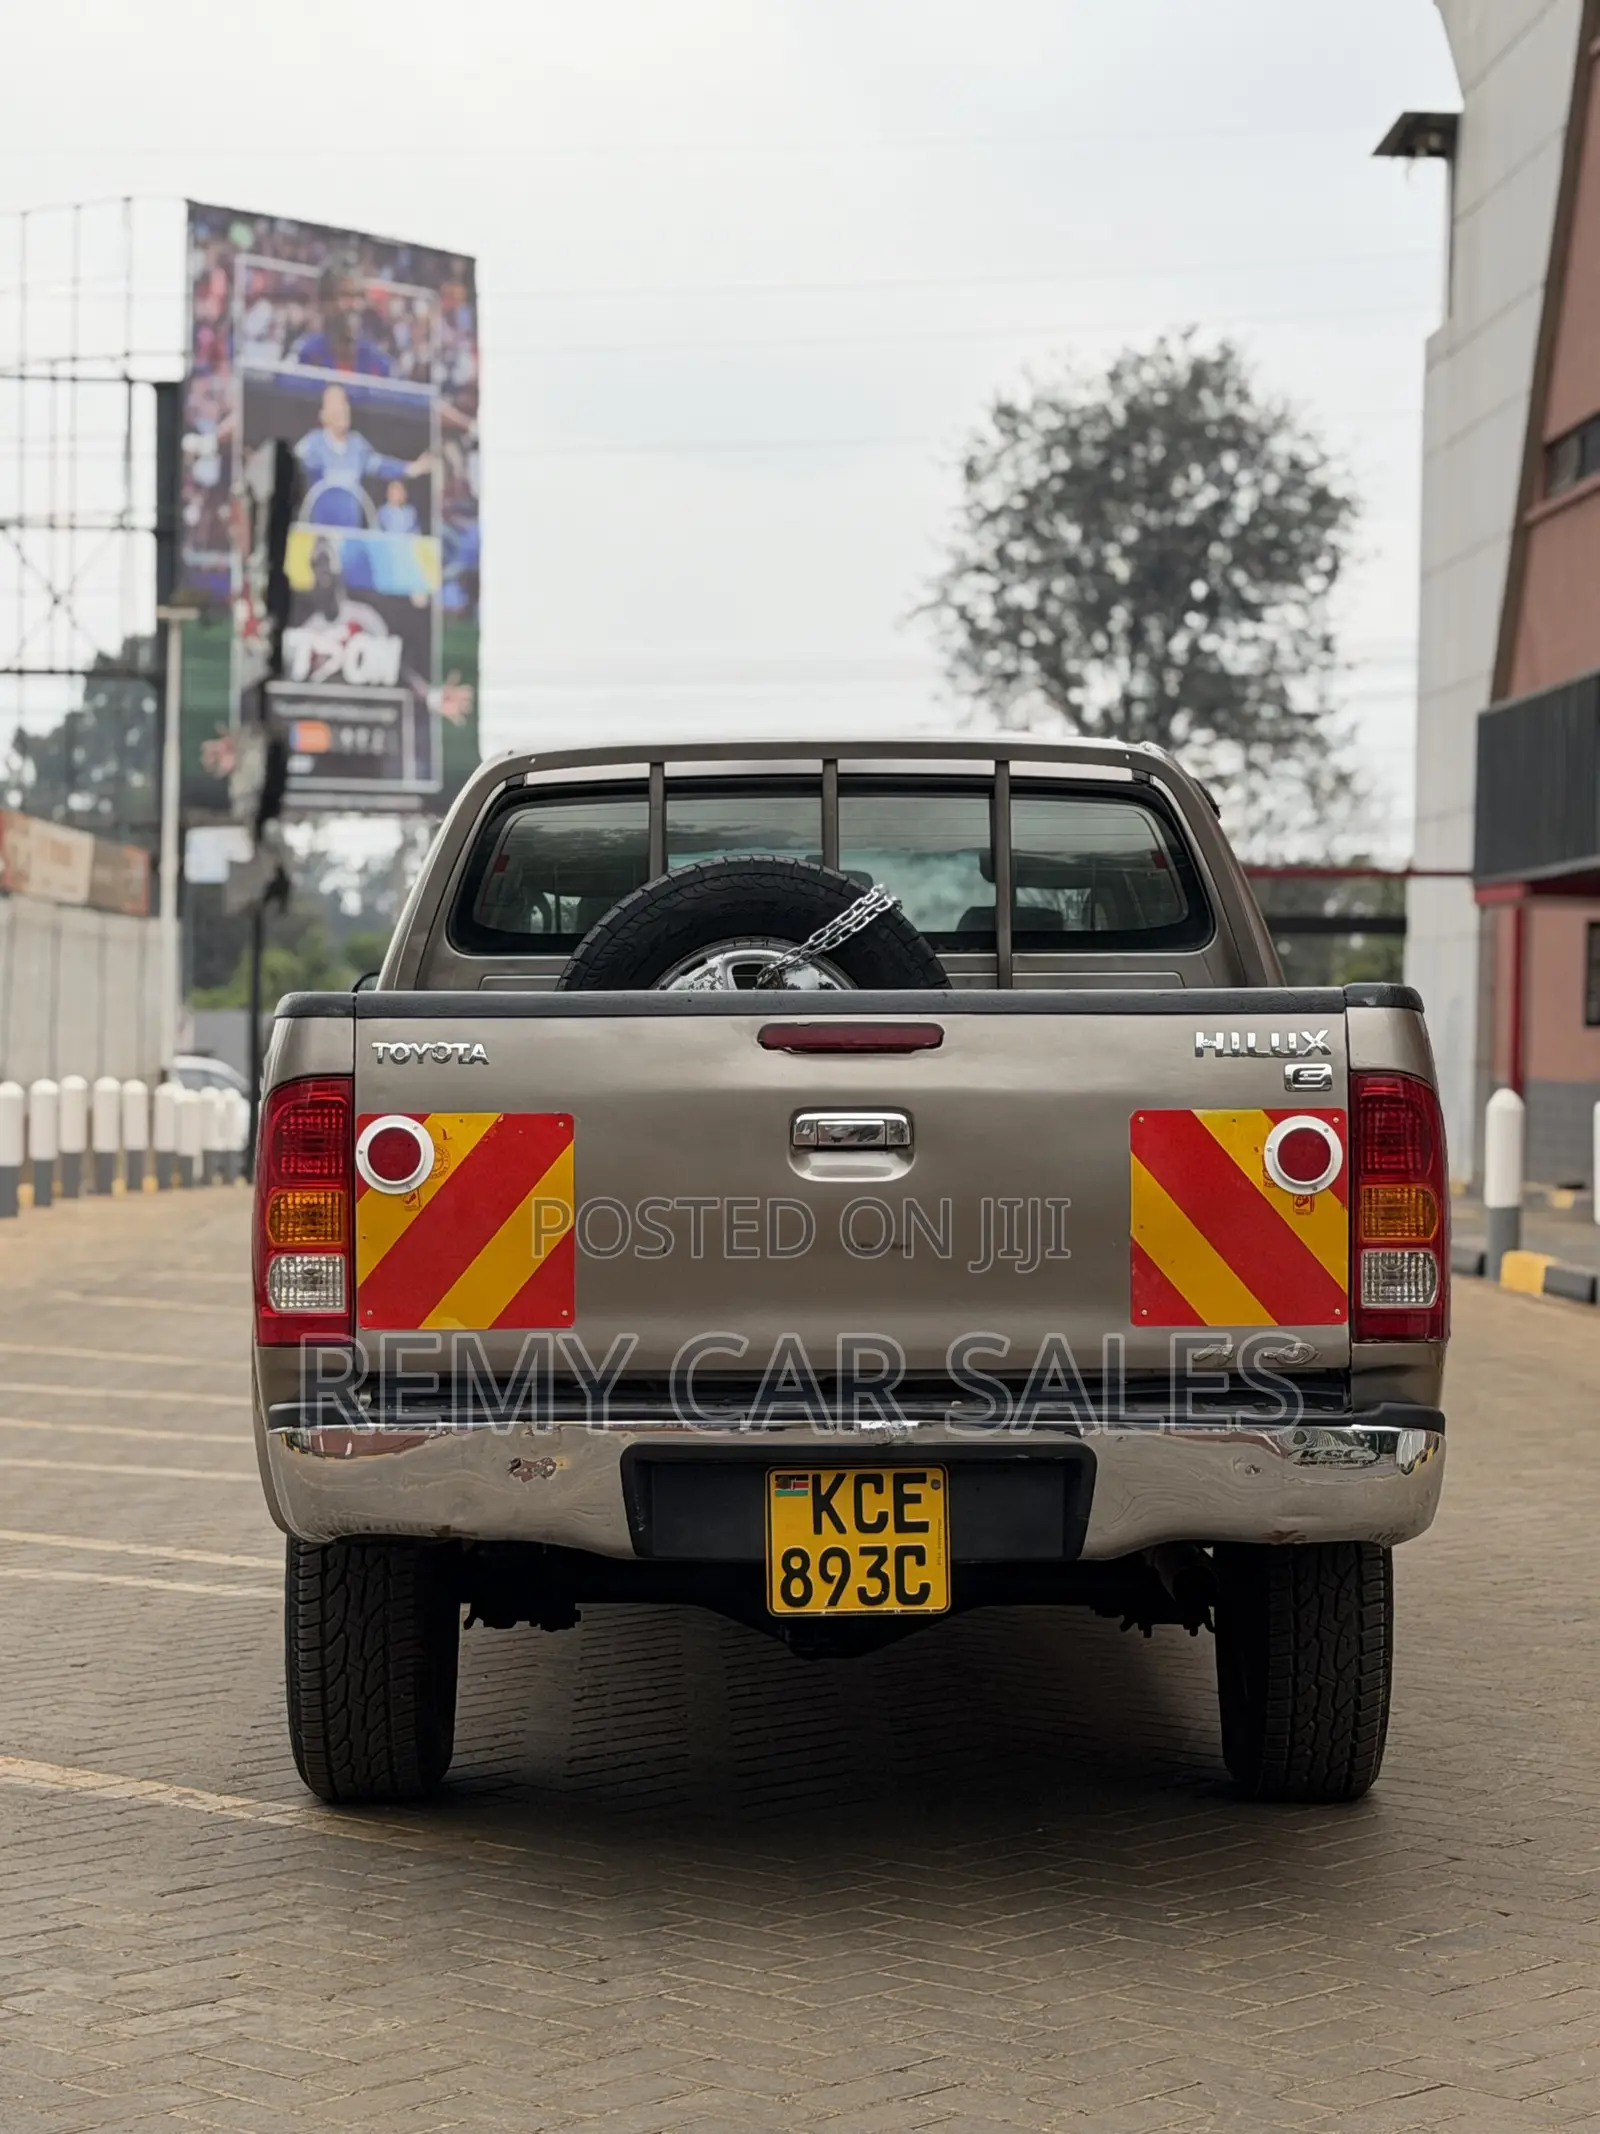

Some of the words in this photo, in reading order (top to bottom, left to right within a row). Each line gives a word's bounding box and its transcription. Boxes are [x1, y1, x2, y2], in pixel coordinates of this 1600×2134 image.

[372, 1041, 490, 1065] TOYOTA
[1195, 1029, 1332, 1058] HILUX
[811, 1472, 930, 1535] KCE
[780, 1544, 931, 1608] 893C
